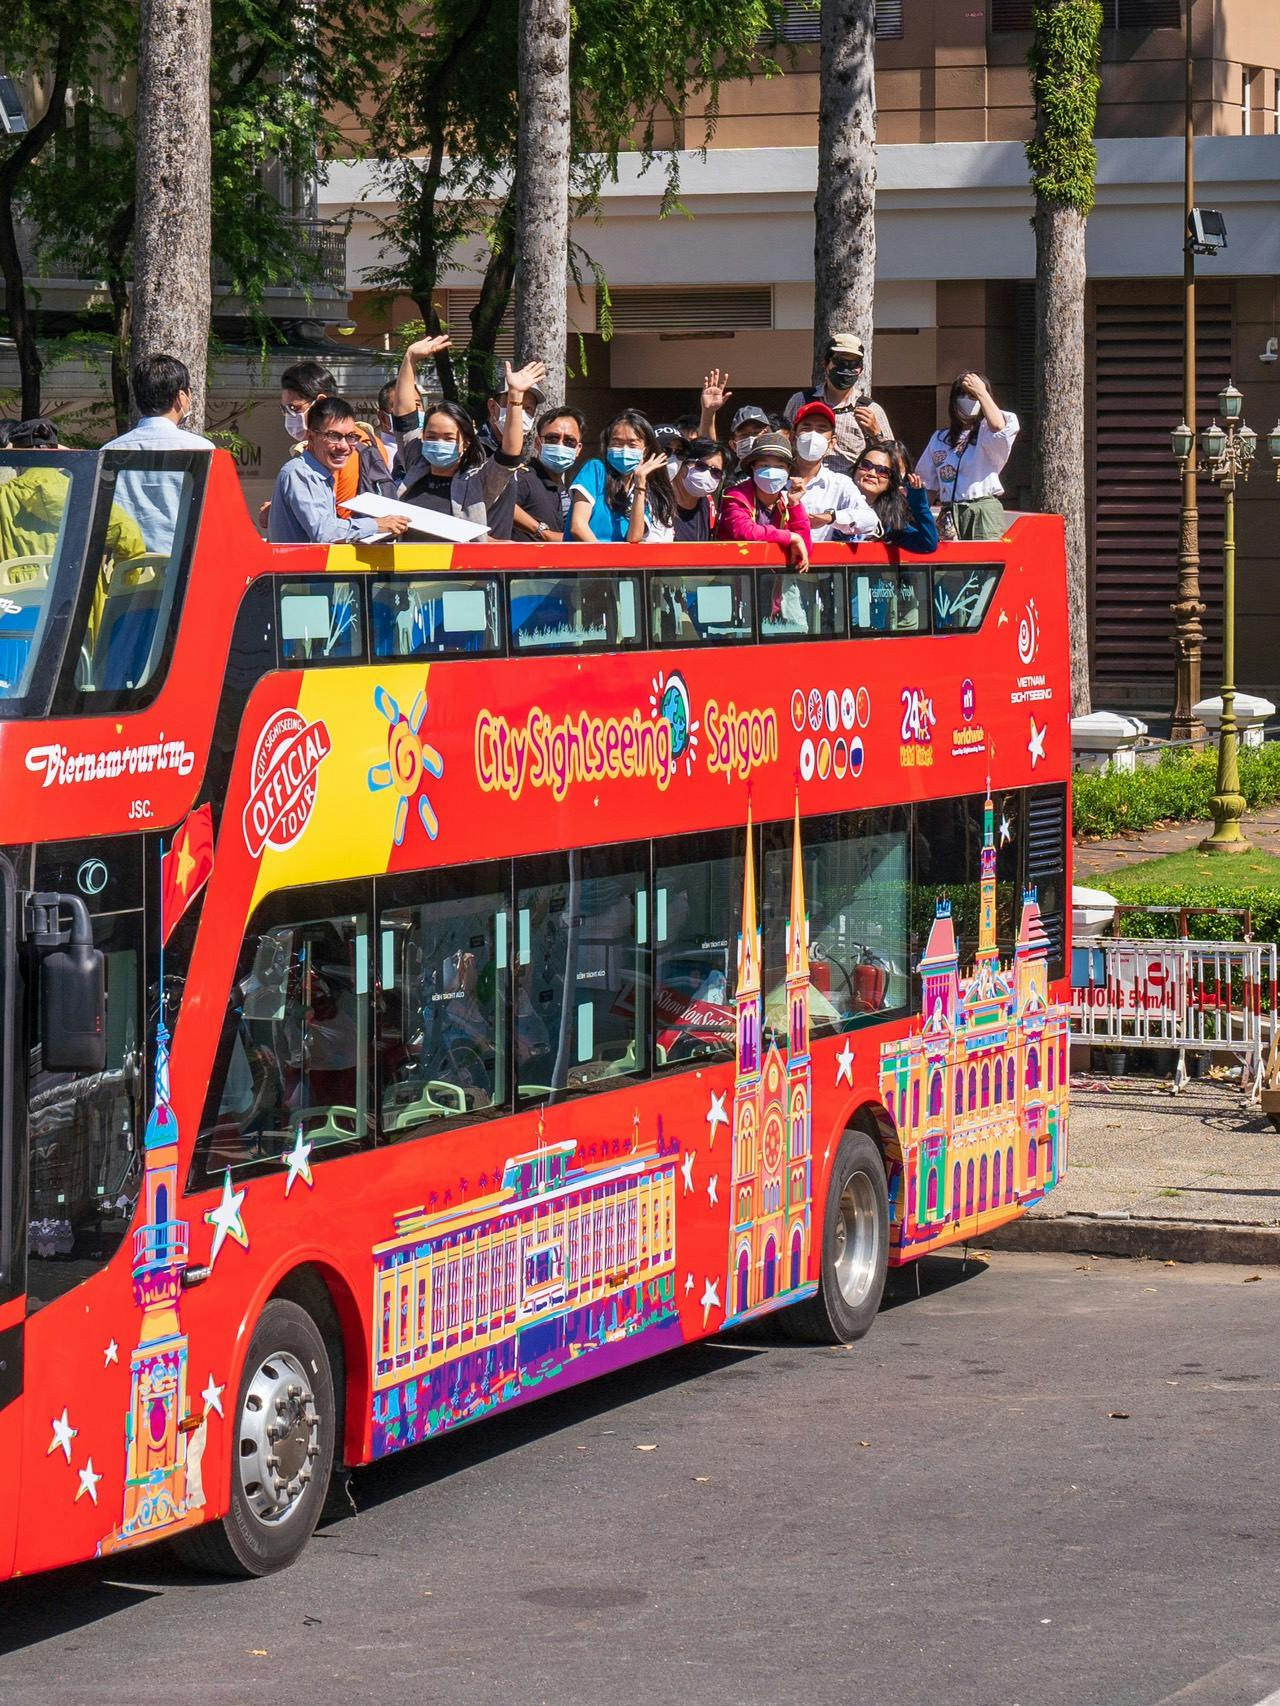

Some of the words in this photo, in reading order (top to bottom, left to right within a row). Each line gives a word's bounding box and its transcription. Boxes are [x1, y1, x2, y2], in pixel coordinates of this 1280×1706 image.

[1016, 675, 1046, 688] VIETNAM
[704, 699, 777, 780] Saigon
[901, 689, 920, 740] 24
[25, 732, 195, 788] Vietnamtourism
[257, 750, 268, 779] CITY
[265, 718, 303, 753] SIGHTSEEING
[128, 799, 155, 819] JSC.
[252, 728, 328, 837] OFFICIAL
[281, 783, 316, 838] TOUR
